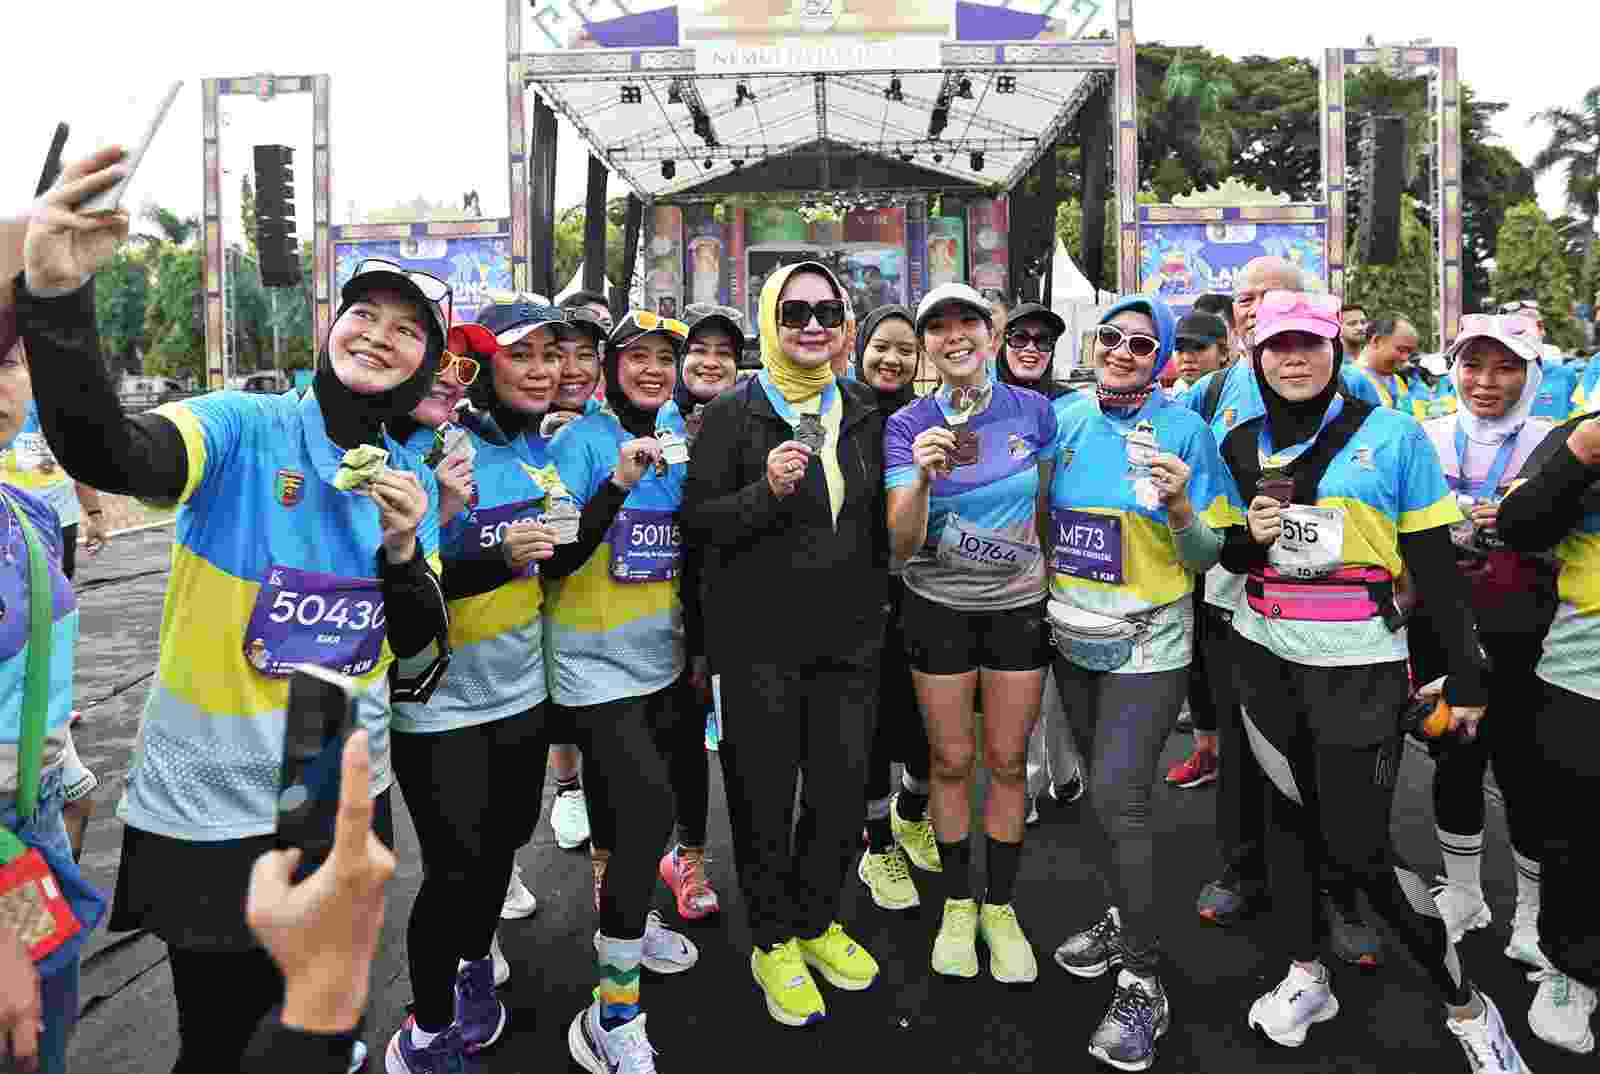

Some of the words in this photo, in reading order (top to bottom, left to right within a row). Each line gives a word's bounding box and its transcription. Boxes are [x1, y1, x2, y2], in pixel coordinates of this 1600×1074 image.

[631, 524, 681, 546] 50115
[960, 532, 1017, 562] 10764
[1060, 522, 1105, 550] MF73
